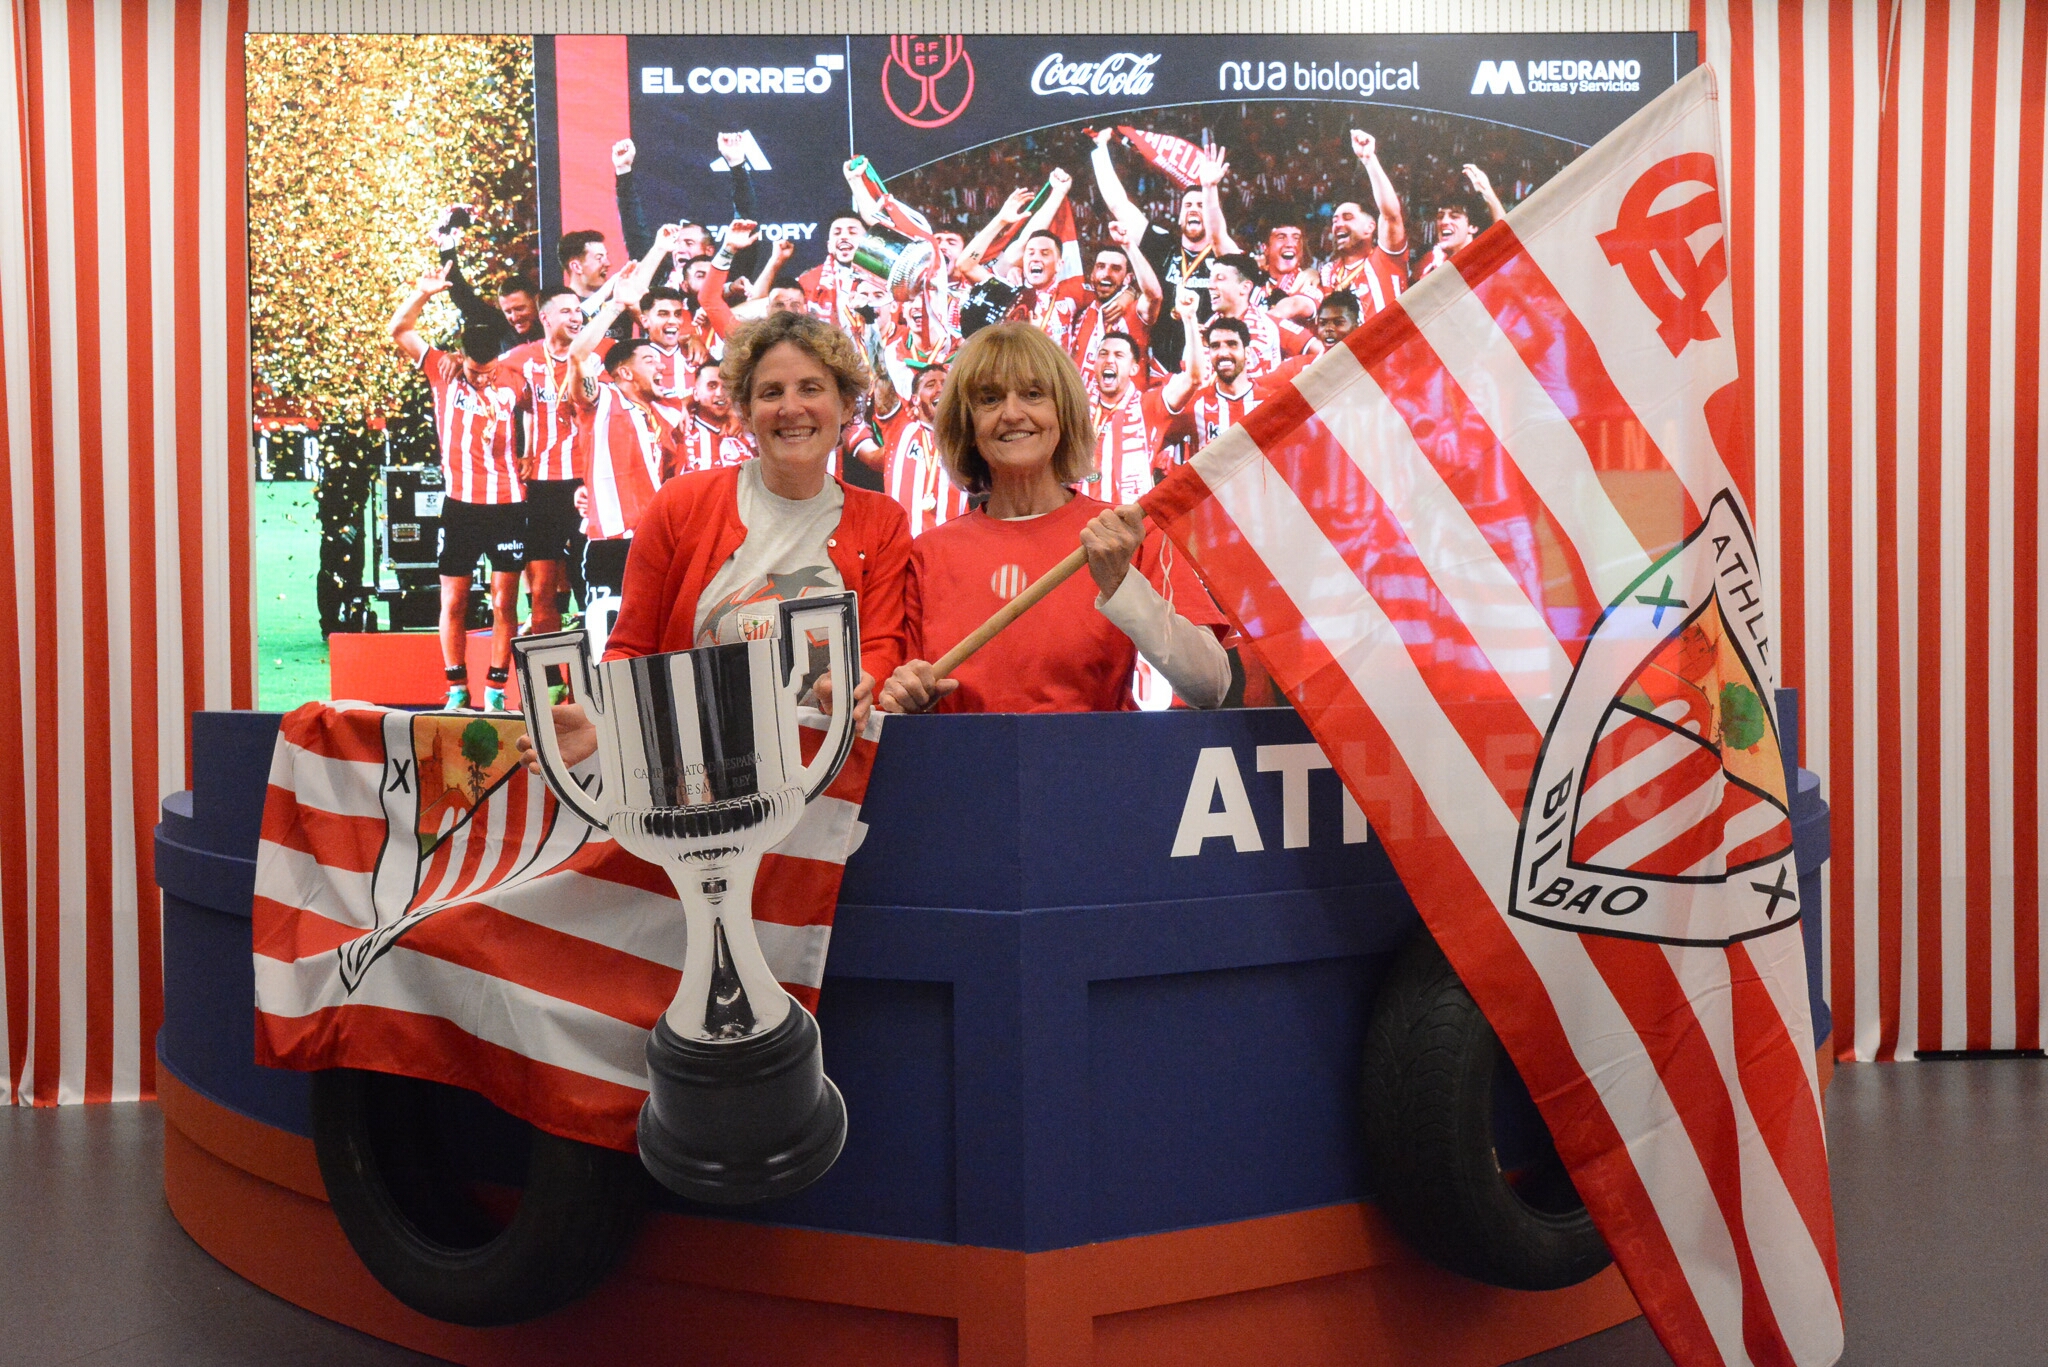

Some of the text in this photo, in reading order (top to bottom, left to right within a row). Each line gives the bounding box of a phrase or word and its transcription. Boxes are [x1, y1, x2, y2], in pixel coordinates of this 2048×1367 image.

[641, 67, 832, 94] EL CORREO
[1031, 52, 1161, 95] Coca-Cola
[1294, 61, 1420, 97] biological
[1528, 60, 1641, 80] MEDRANO
[1528, 80, 1640, 95] Obras y Servicios
[1711, 535, 1773, 684] ATHLE
